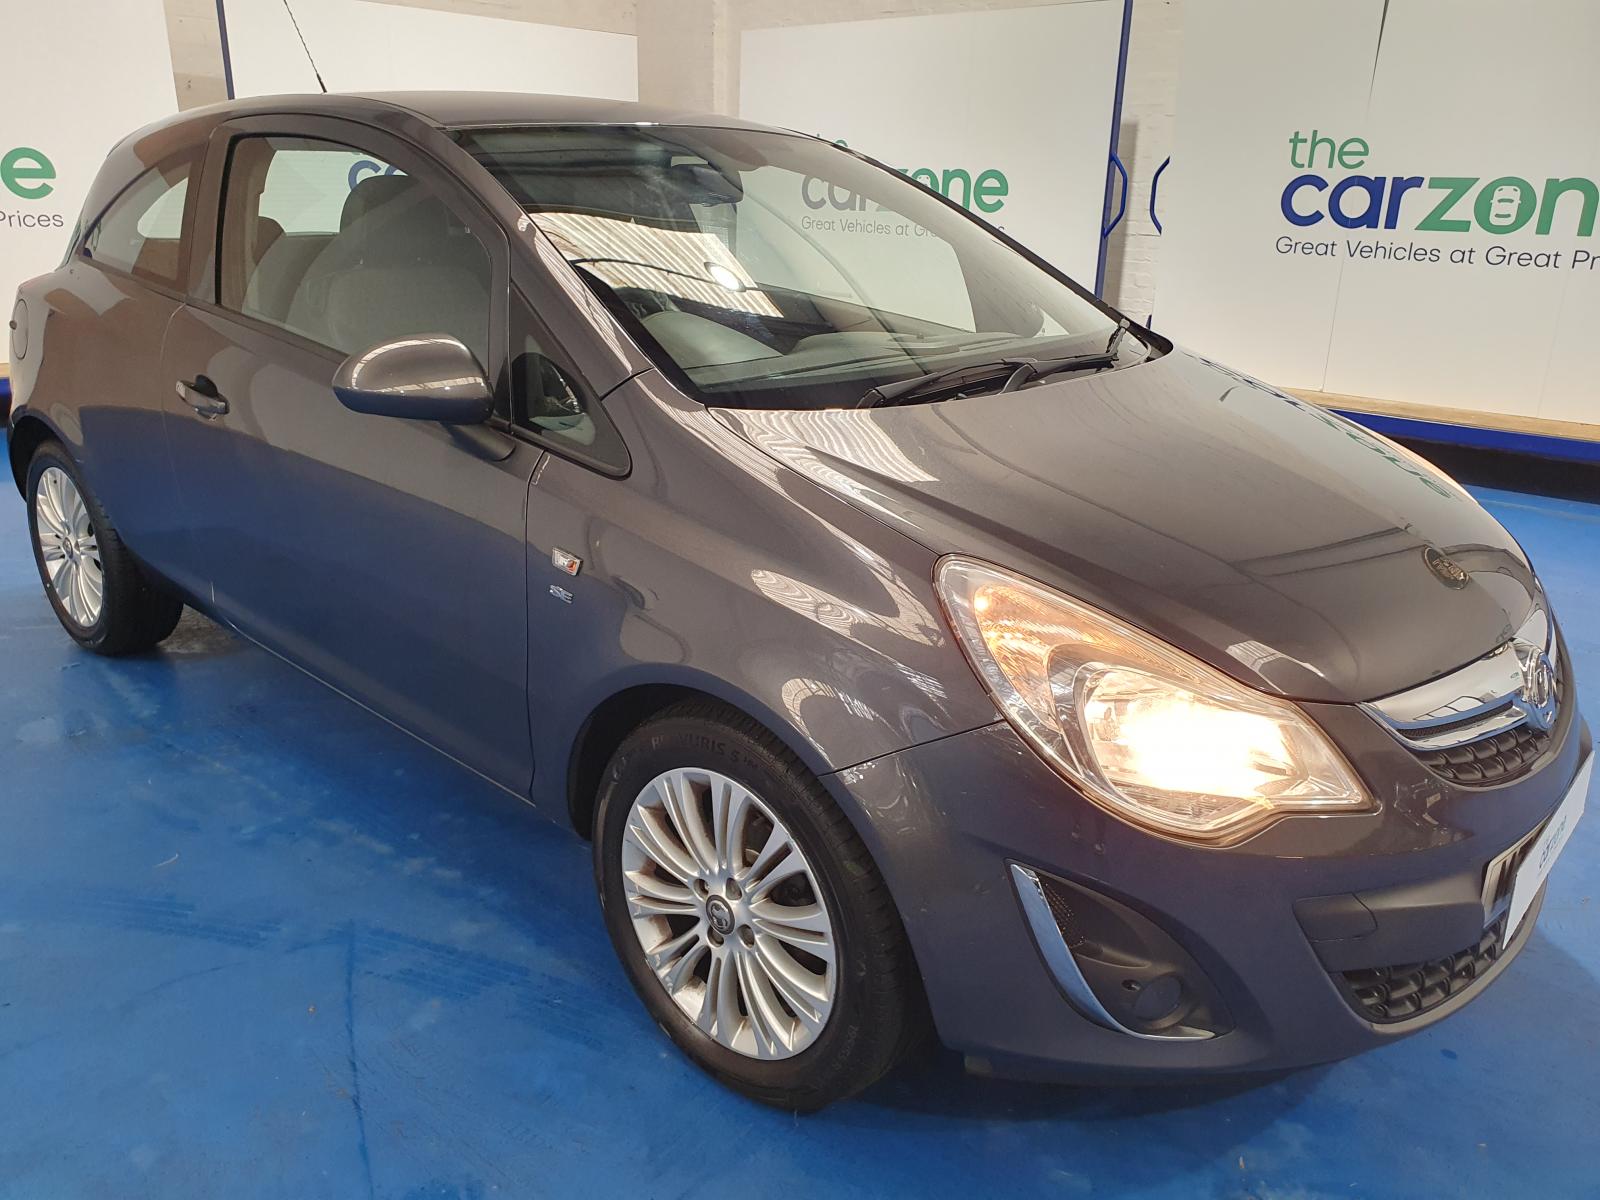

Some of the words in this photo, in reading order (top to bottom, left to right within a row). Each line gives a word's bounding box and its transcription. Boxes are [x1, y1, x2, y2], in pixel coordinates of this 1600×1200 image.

[1289, 130, 1370, 169] the
[801, 215, 836, 232] Great
[840, 218, 891, 235] Vehicles
[895, 223, 909, 237] at
[1275, 236, 1337, 257] Great
[1346, 239, 1441, 263] Vehicles
[1449, 247, 1476, 265] at
[1485, 245, 1562, 269] Great
